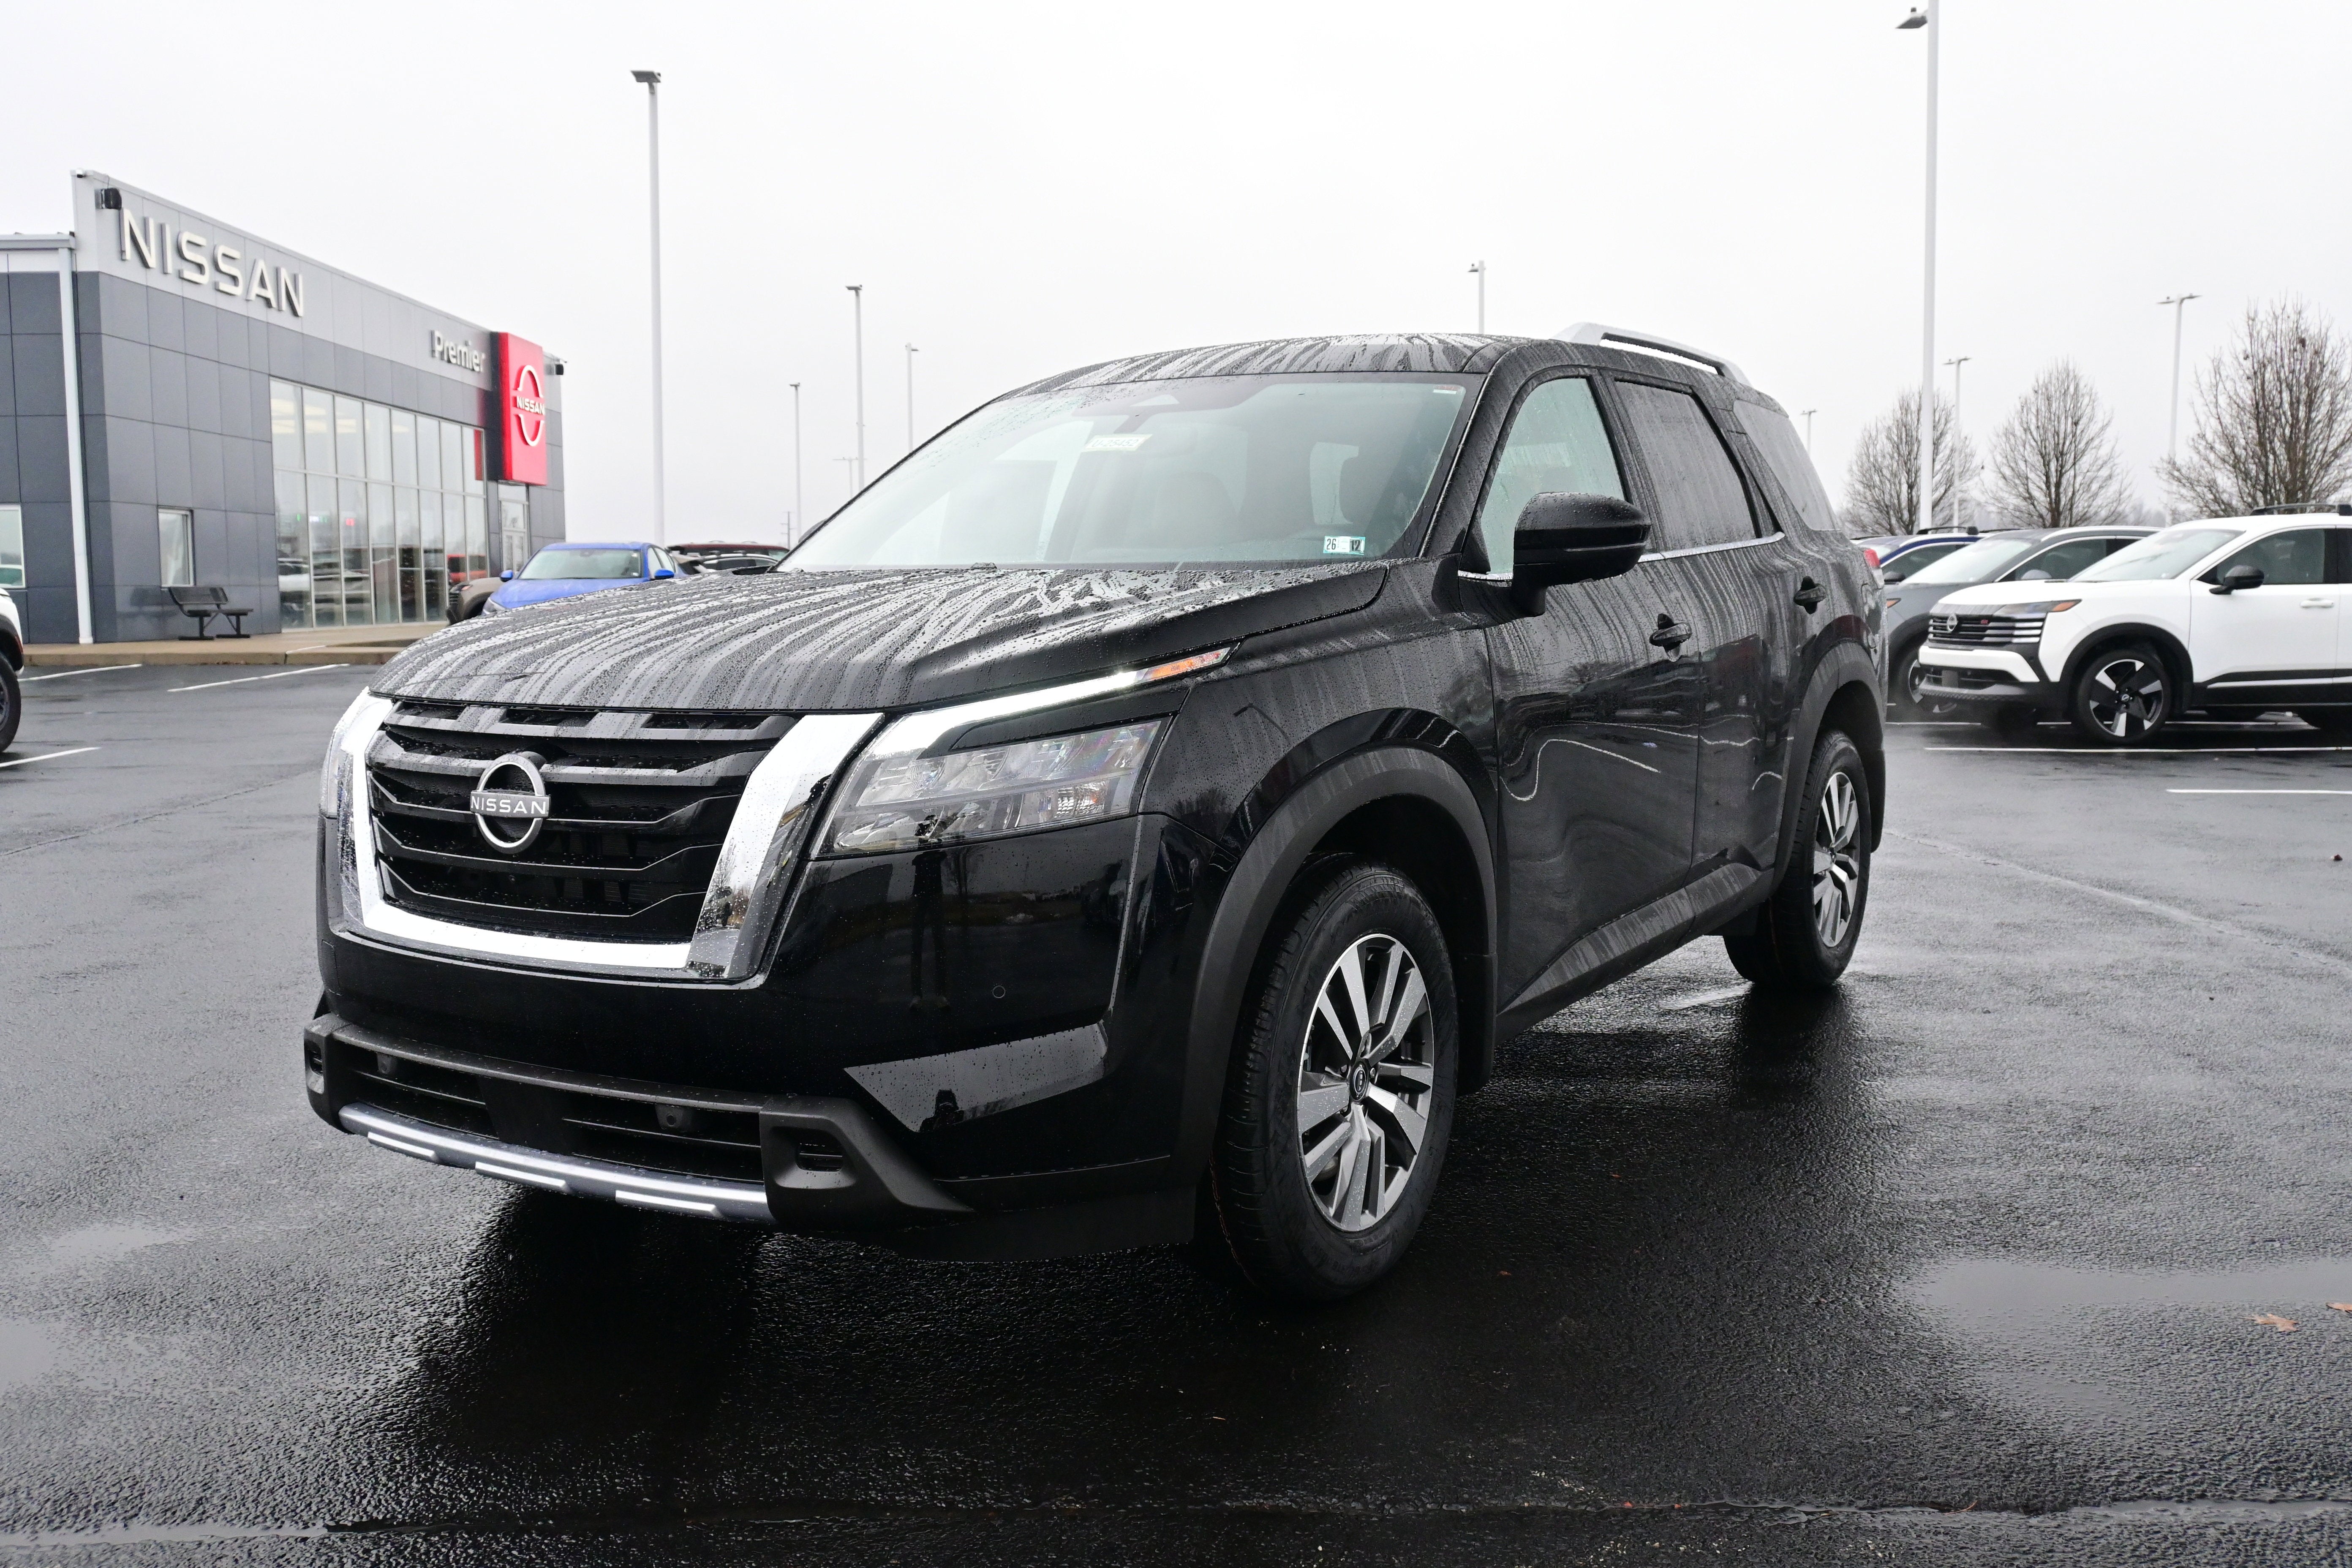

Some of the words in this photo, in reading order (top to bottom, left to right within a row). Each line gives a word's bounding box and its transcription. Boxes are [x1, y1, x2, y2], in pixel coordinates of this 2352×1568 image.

[120, 207, 304, 318] NISSAN
[431, 329, 485, 373] Premier
[516, 395, 545, 416] NISSAN
[1326, 538, 1337, 550] 26
[1350, 539, 1361, 551] 12
[471, 795, 547, 814] NISSAN
